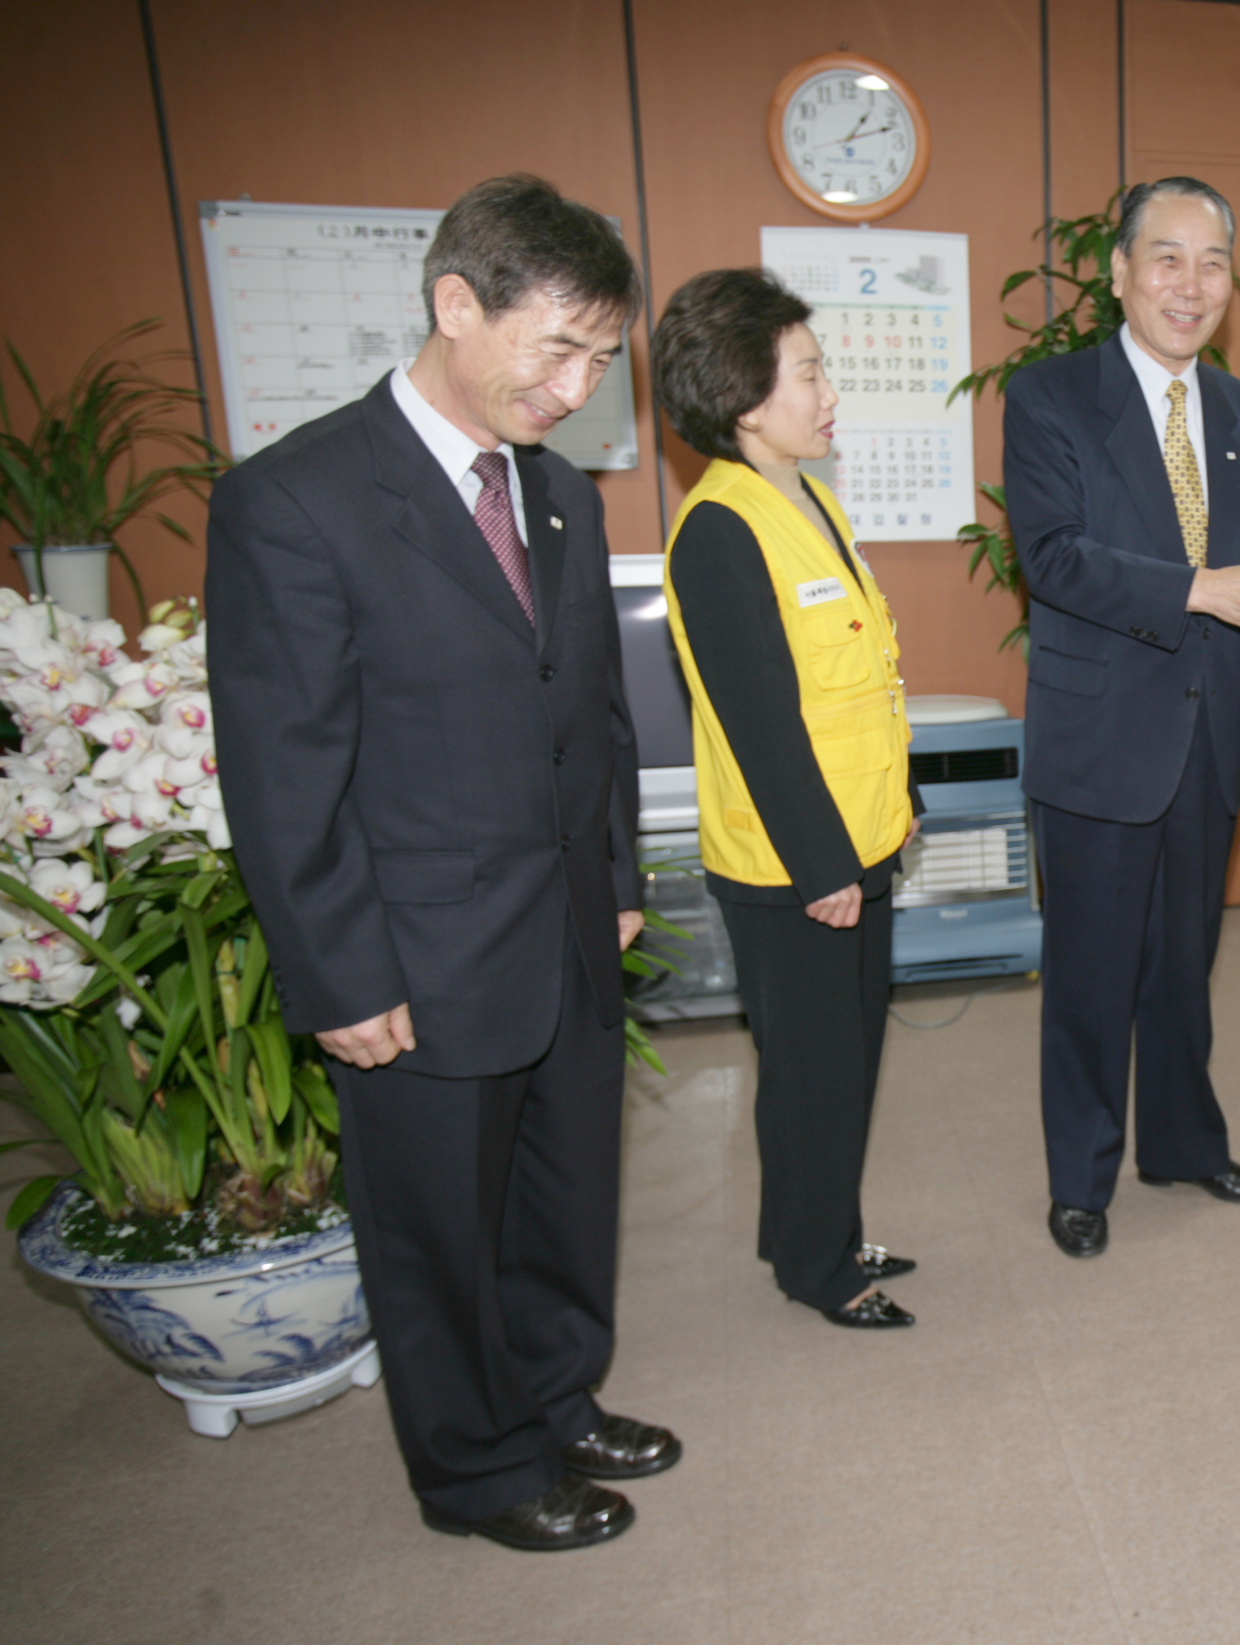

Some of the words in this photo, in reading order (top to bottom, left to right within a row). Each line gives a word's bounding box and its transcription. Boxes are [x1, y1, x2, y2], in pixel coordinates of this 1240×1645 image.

[817, 85, 832, 105] 11
[838, 80, 858, 99] 12
[800, 101, 817, 120] 10
[860, 269, 878, 295] 2
[842, 312, 849, 325] 1
[864, 313, 874, 326] 2
[887, 313, 897, 326] 3
[910, 314, 920, 326] 4
[933, 314, 943, 328] 5
[842, 335, 851, 348] 8
[865, 335, 875, 348] 9
[884, 335, 903, 348] 10
[908, 336, 923, 348] 11
[931, 336, 948, 350] 12
[840, 357, 857, 370] 15
[863, 357, 880, 370] 16
[885, 358, 902, 370] 17
[909, 358, 926, 371] 18
[931, 358, 949, 371] 19
[840, 379, 857, 392] 22
[863, 379, 880, 392] 23
[885, 380, 903, 393] 24
[909, 380, 927, 393] 25
[931, 380, 949, 393] 26
